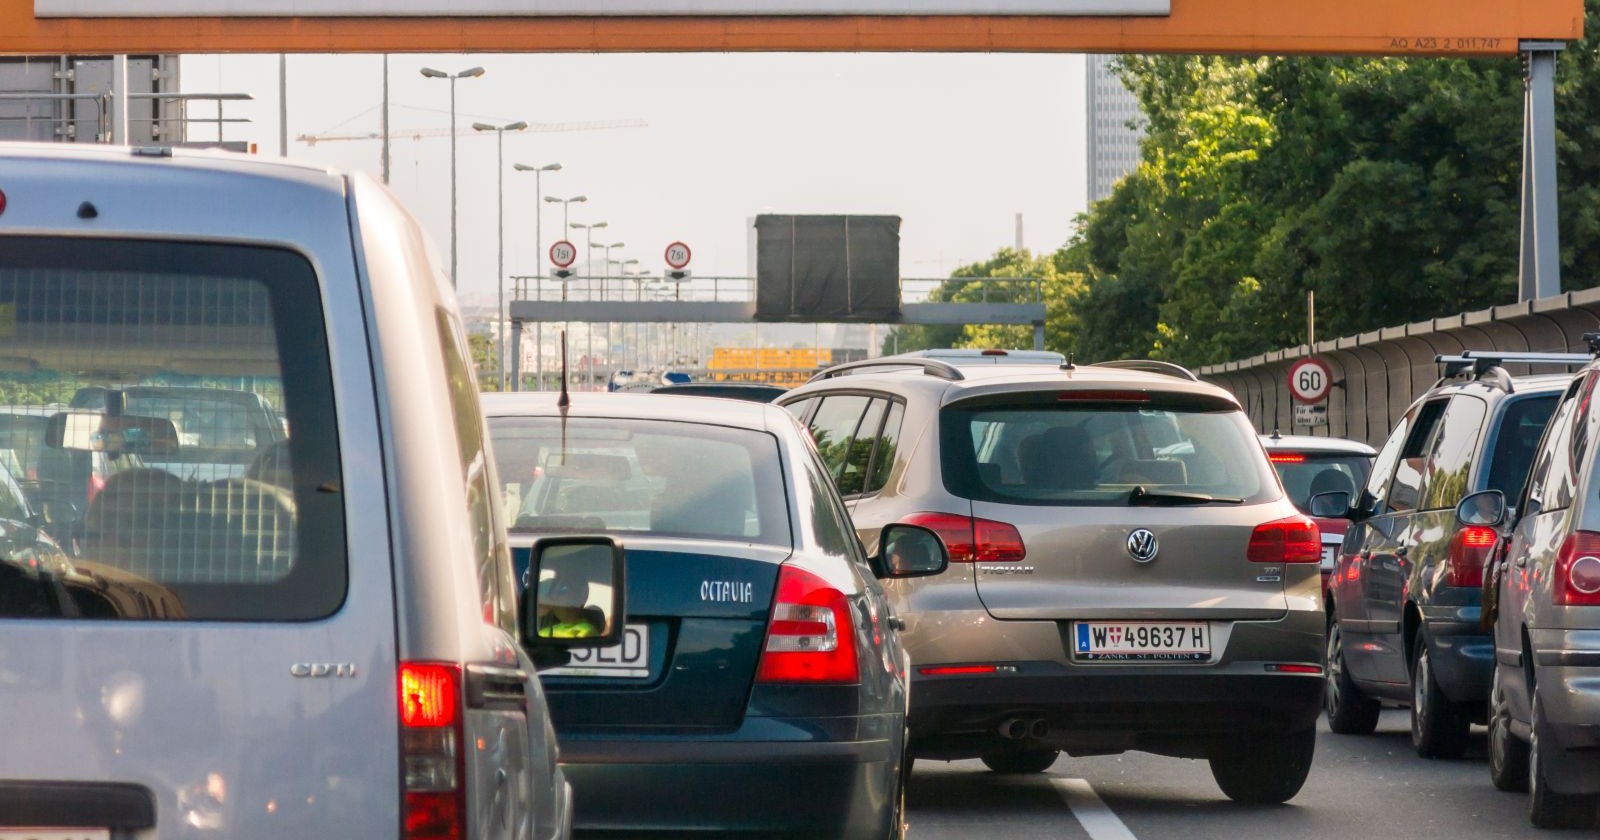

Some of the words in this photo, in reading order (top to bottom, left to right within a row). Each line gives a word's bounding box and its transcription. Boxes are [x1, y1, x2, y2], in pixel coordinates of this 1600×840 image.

[1300, 371, 1321, 391] 60
[700, 580, 752, 603] OCTAVIA
[1092, 627, 1108, 648] W
[1124, 626, 1186, 648] 49637
[1191, 627, 1204, 648] H
